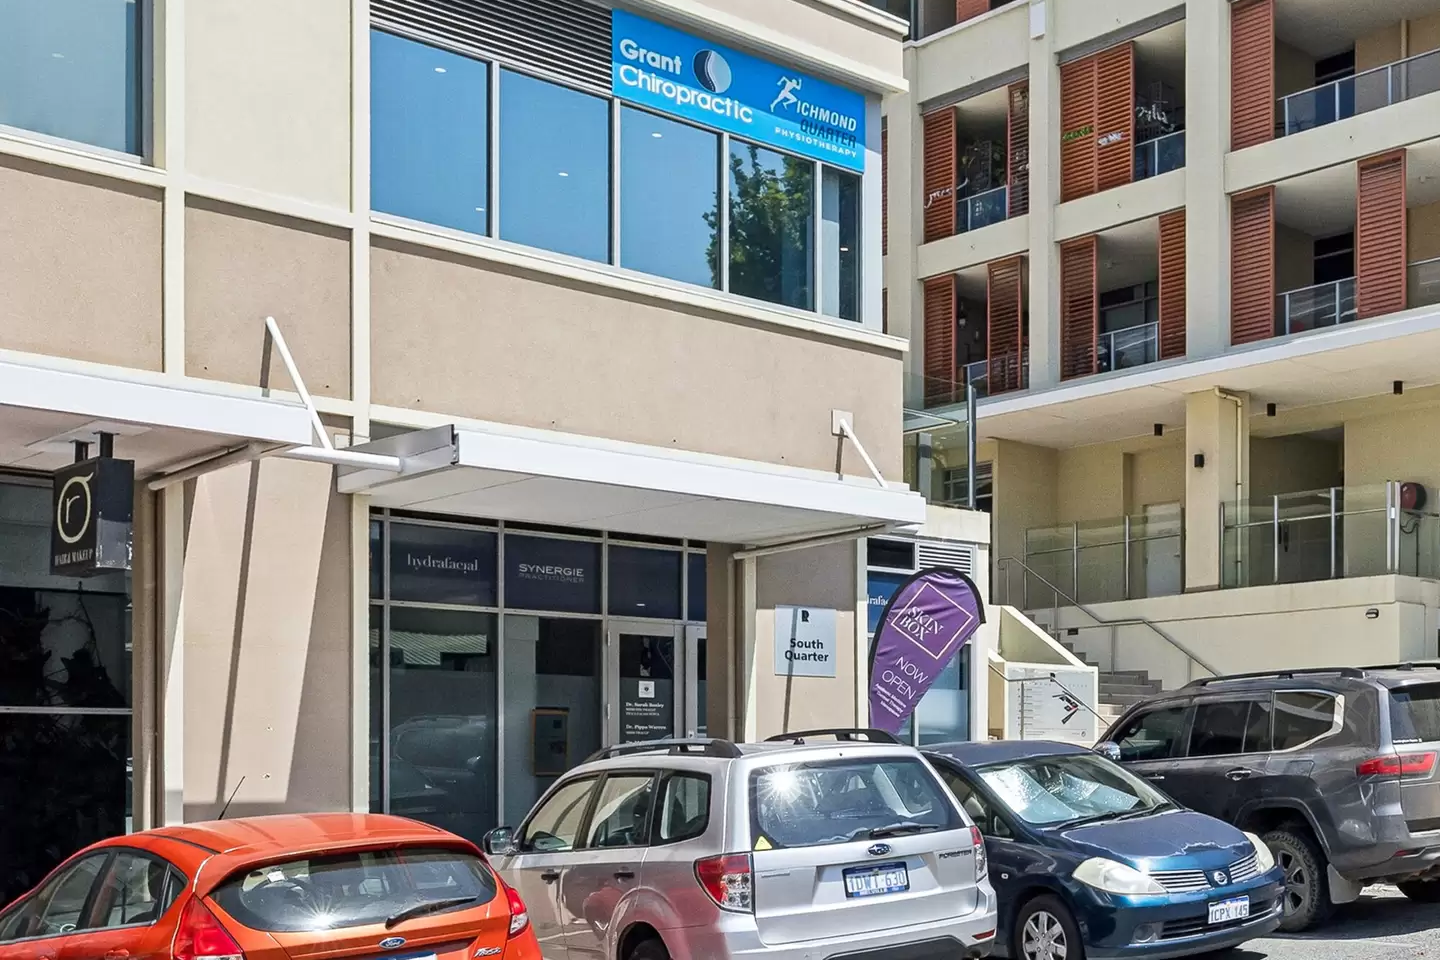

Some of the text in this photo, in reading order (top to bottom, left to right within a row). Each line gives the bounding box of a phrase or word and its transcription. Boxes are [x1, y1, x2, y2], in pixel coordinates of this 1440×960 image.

[620, 39, 682, 75] Grant
[620, 64, 753, 124] Chiropractic
[774, 127, 857, 159] PHYSIOTHERAPY
[800, 118, 857, 149] QUARTER
[407, 553, 479, 574] hydrafacial
[518, 563, 585, 577] SYNERGIE
[900, 615, 931, 641] BOX
[908, 606, 944, 635] SKIN
[784, 649, 830, 662] Quarter
[789, 637, 824, 650] South
[895, 656, 929, 684] NOW
[881, 669, 917, 700] OPEN
